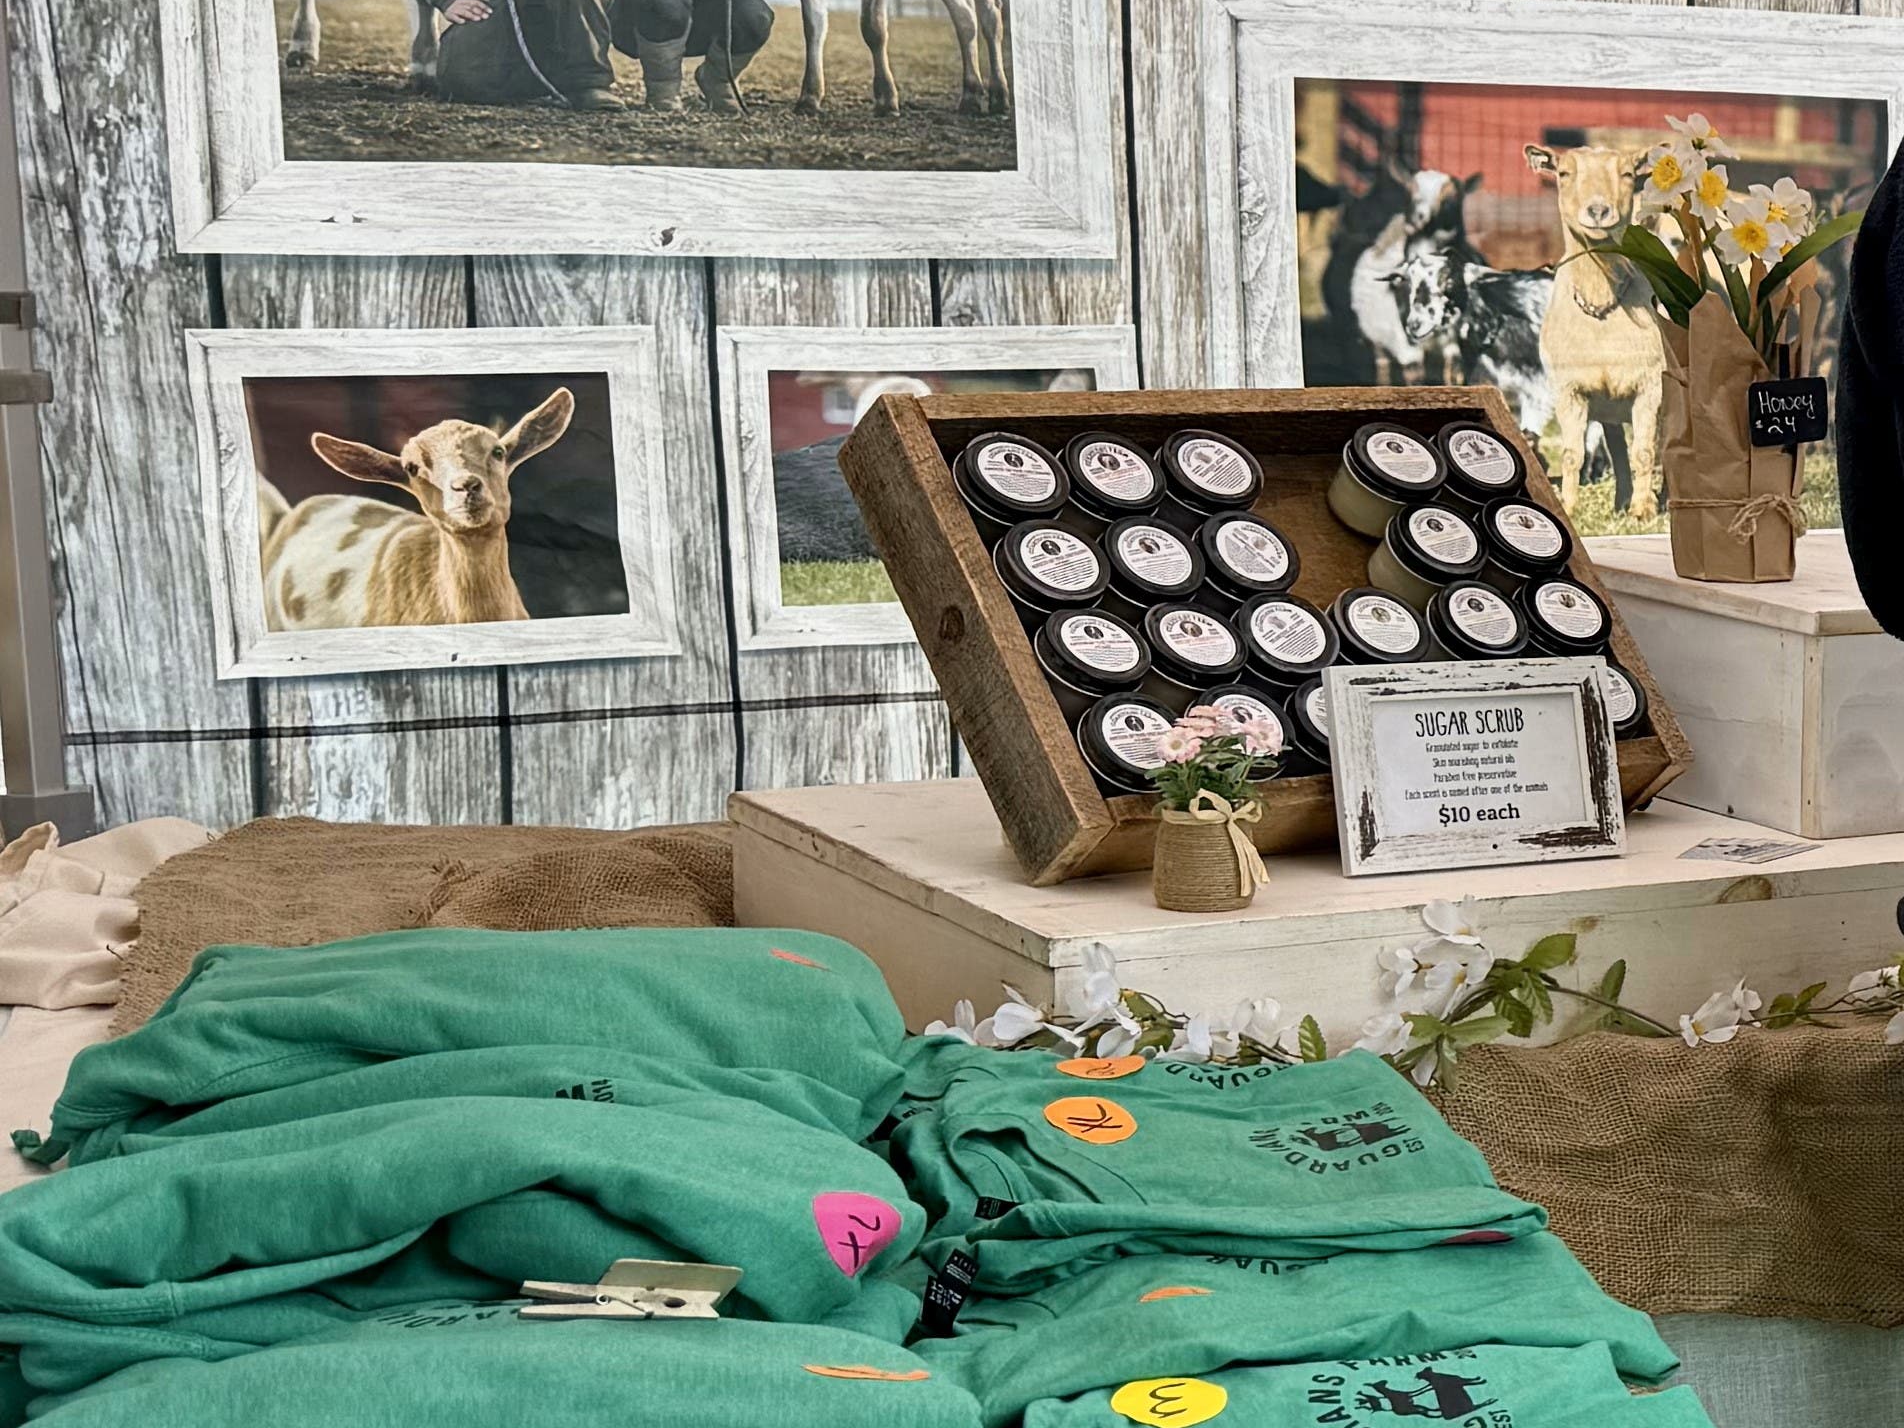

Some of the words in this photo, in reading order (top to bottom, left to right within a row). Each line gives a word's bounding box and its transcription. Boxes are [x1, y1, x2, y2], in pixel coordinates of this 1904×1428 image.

[1758, 391, 1815, 419] Honey
[1415, 711, 1470, 738] SUGAR
[1475, 707, 1525, 734] SCRUB
[1439, 803, 1471, 827] $10
[1476, 802, 1521, 821] each
